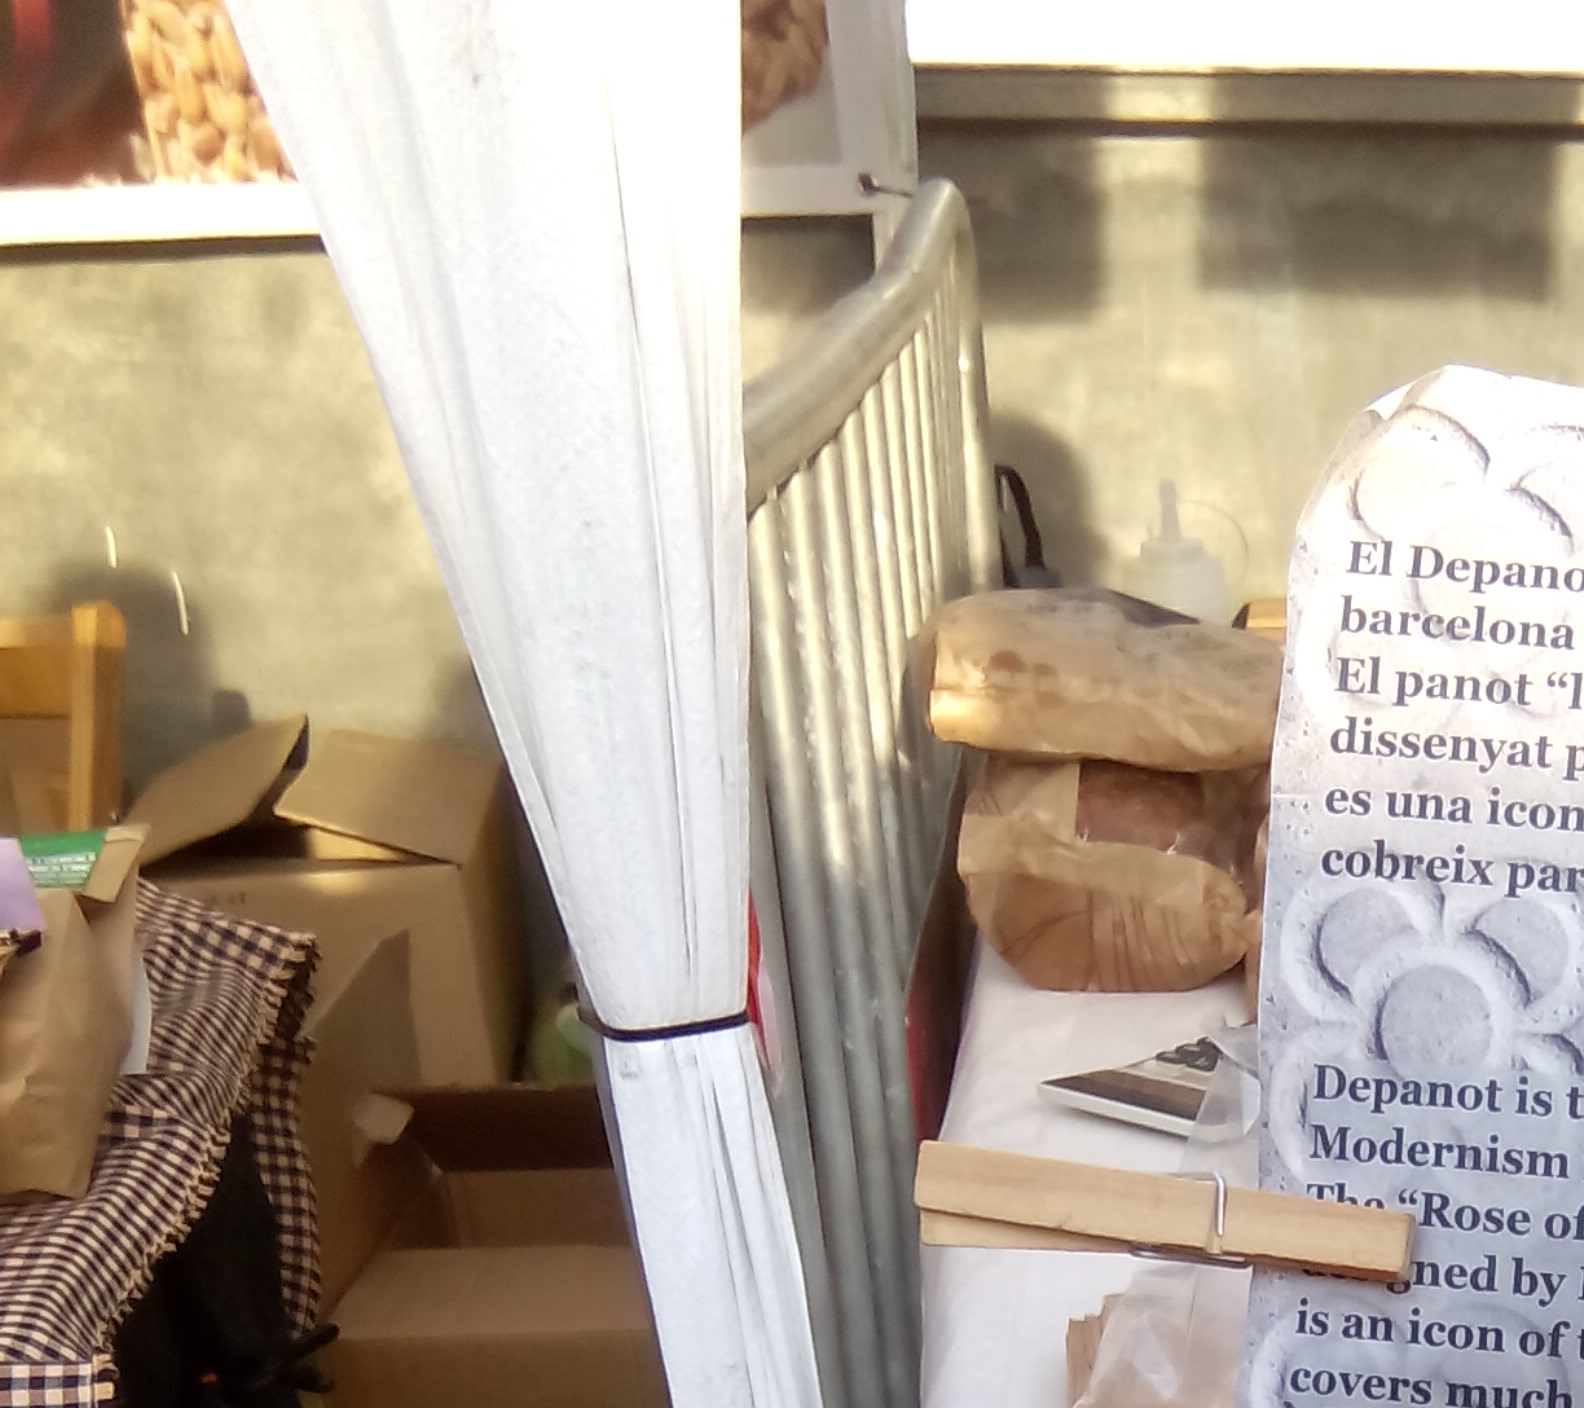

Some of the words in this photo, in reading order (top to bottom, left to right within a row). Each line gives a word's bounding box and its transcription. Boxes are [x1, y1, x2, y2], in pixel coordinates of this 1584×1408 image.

[1347, 540, 1395, 578] El
[1340, 596, 1576, 652] barcelona
[1336, 657, 1382, 694] El
[1396, 670, 1533, 707] panot
[1329, 717, 1555, 775] dissenyat
[1324, 788, 1372, 816] es
[1386, 793, 1474, 826] una
[1321, 844, 1494, 887] cobreix
[1313, 1064, 1503, 1114] Depanot
[1515, 1076, 1553, 1117] is
[1309, 1124, 1569, 1177] Modernism
[1513, 1265, 1566, 1306] by
[1296, 1298, 1330, 1336] is
[1342, 1311, 1394, 1341] an
[1407, 1308, 1505, 1351] icon
[1519, 1323, 1570, 1358] of
[1289, 1368, 1433, 1404] covers
